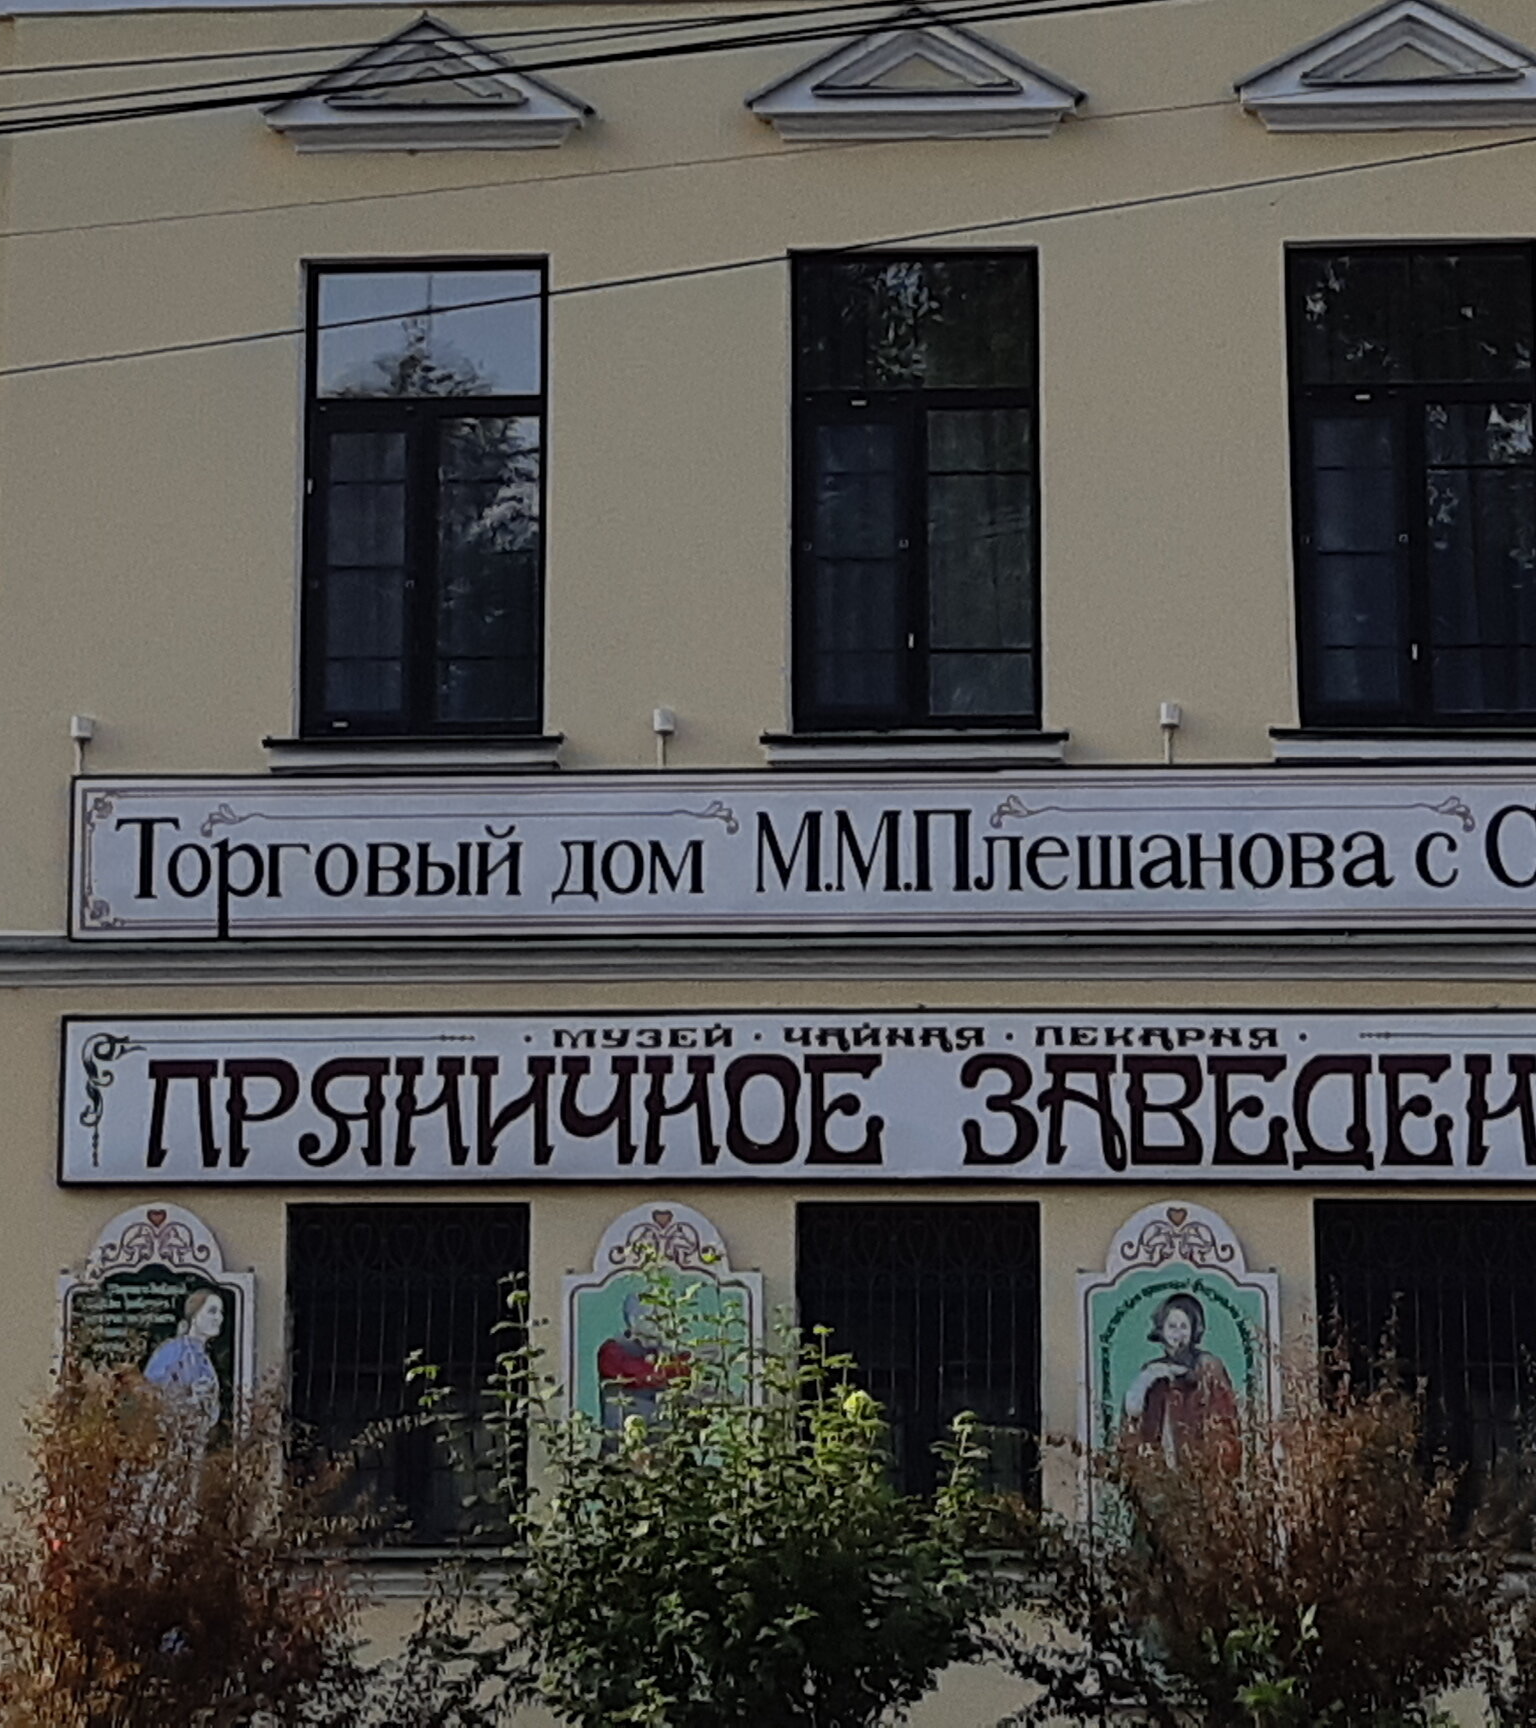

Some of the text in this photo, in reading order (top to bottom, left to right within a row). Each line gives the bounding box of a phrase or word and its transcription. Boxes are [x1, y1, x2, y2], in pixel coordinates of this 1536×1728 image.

[114, 815, 522, 935] Торговый
[552, 838, 704, 903] дом
[552, 1022, 1279, 1053] МУЗЕЙ ЧАЙНАЯ ПЕКАРНЯ
[146, 1053, 885, 1170] ПРЯНИЧНОЕ
